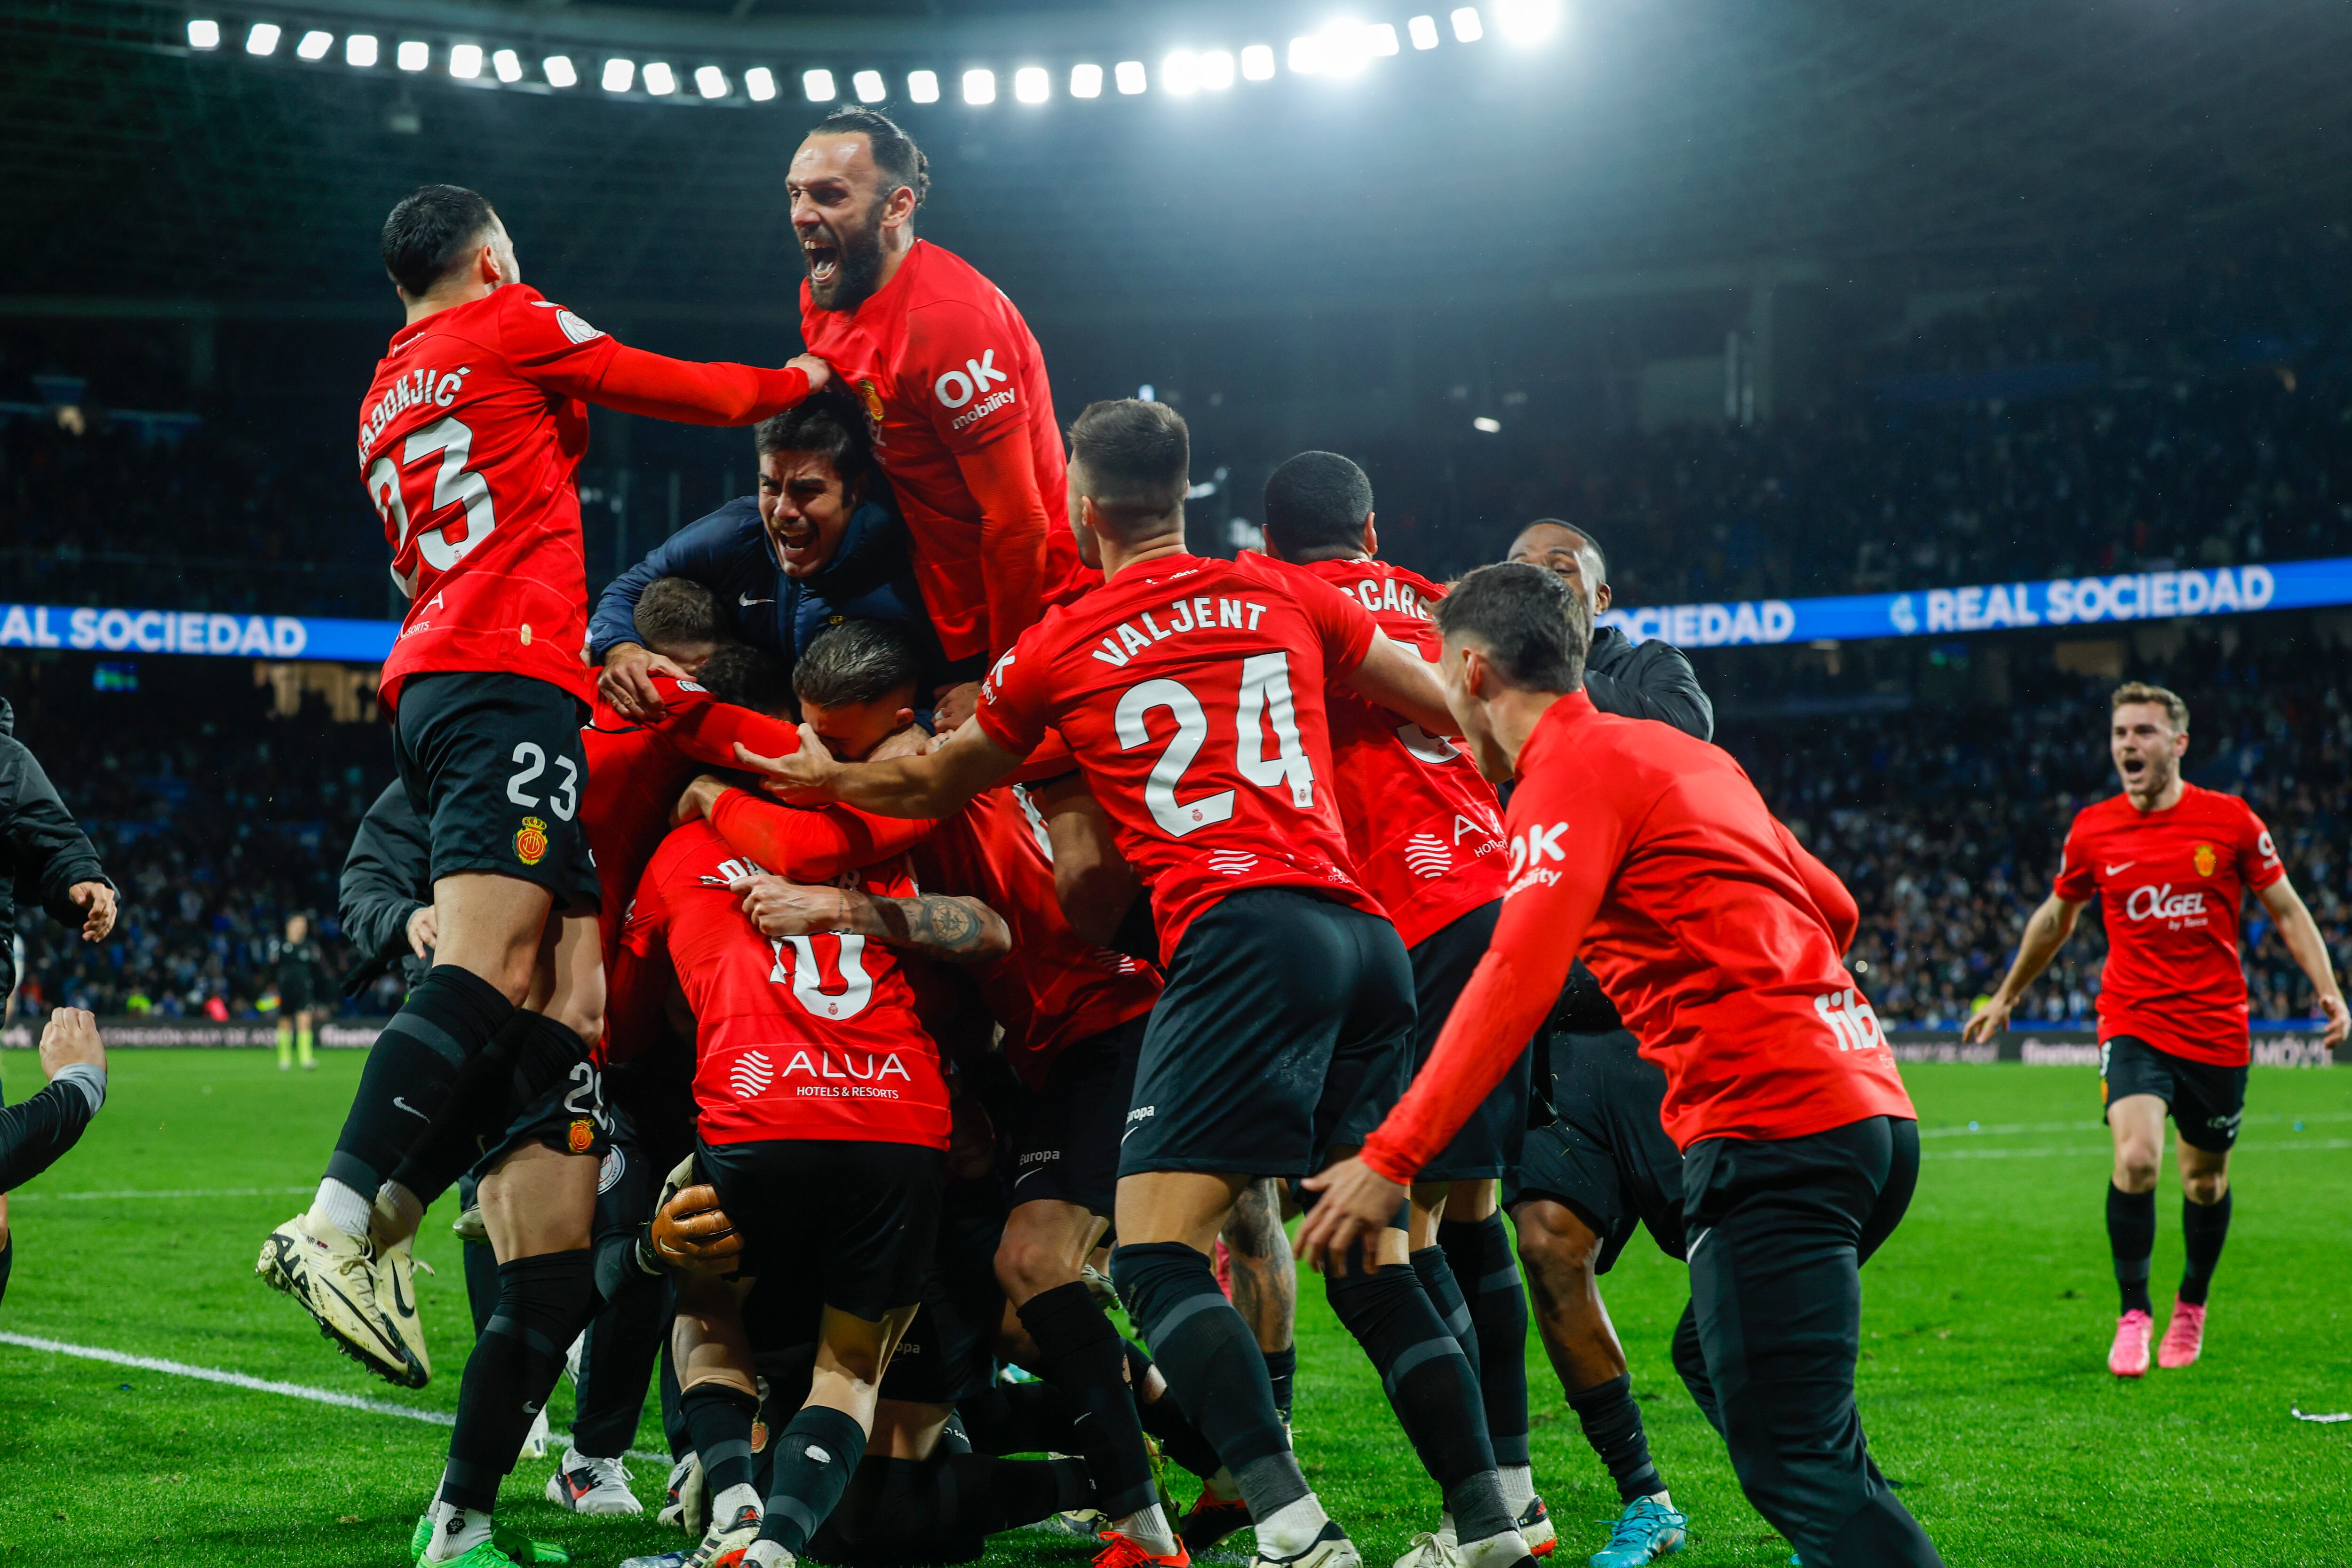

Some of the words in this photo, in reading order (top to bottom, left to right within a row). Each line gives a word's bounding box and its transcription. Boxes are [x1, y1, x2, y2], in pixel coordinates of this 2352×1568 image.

[935, 349, 1007, 408] OK
[952, 388, 1015, 429] mobility
[1927, 584, 2039, 633] REAL
[2047, 565, 2275, 625] SOCIEDAD
[0, 605, 60, 647] AL
[69, 607, 307, 657] SOCIEDAD
[1091, 597, 1267, 667] VALJENT
[1599, 600, 1795, 647] OCIEDAD
[990, 647, 1016, 687] K
[1114, 651, 1315, 838] 24
[506, 741, 578, 822] 23
[1508, 822, 1569, 882] OK
[2257, 831, 2276, 857] O
[1814, 988, 1887, 1052] fib
[782, 1051, 911, 1081] ALUA
[797, 1086, 839, 1096] HOTELS
[842, 1087, 850, 1096] &
[852, 1087, 899, 1099] RESORTS
[1020, 1151, 1060, 1166] Europa
[307, 1235, 315, 1245] NR
[896, 1343, 920, 1354] opa
